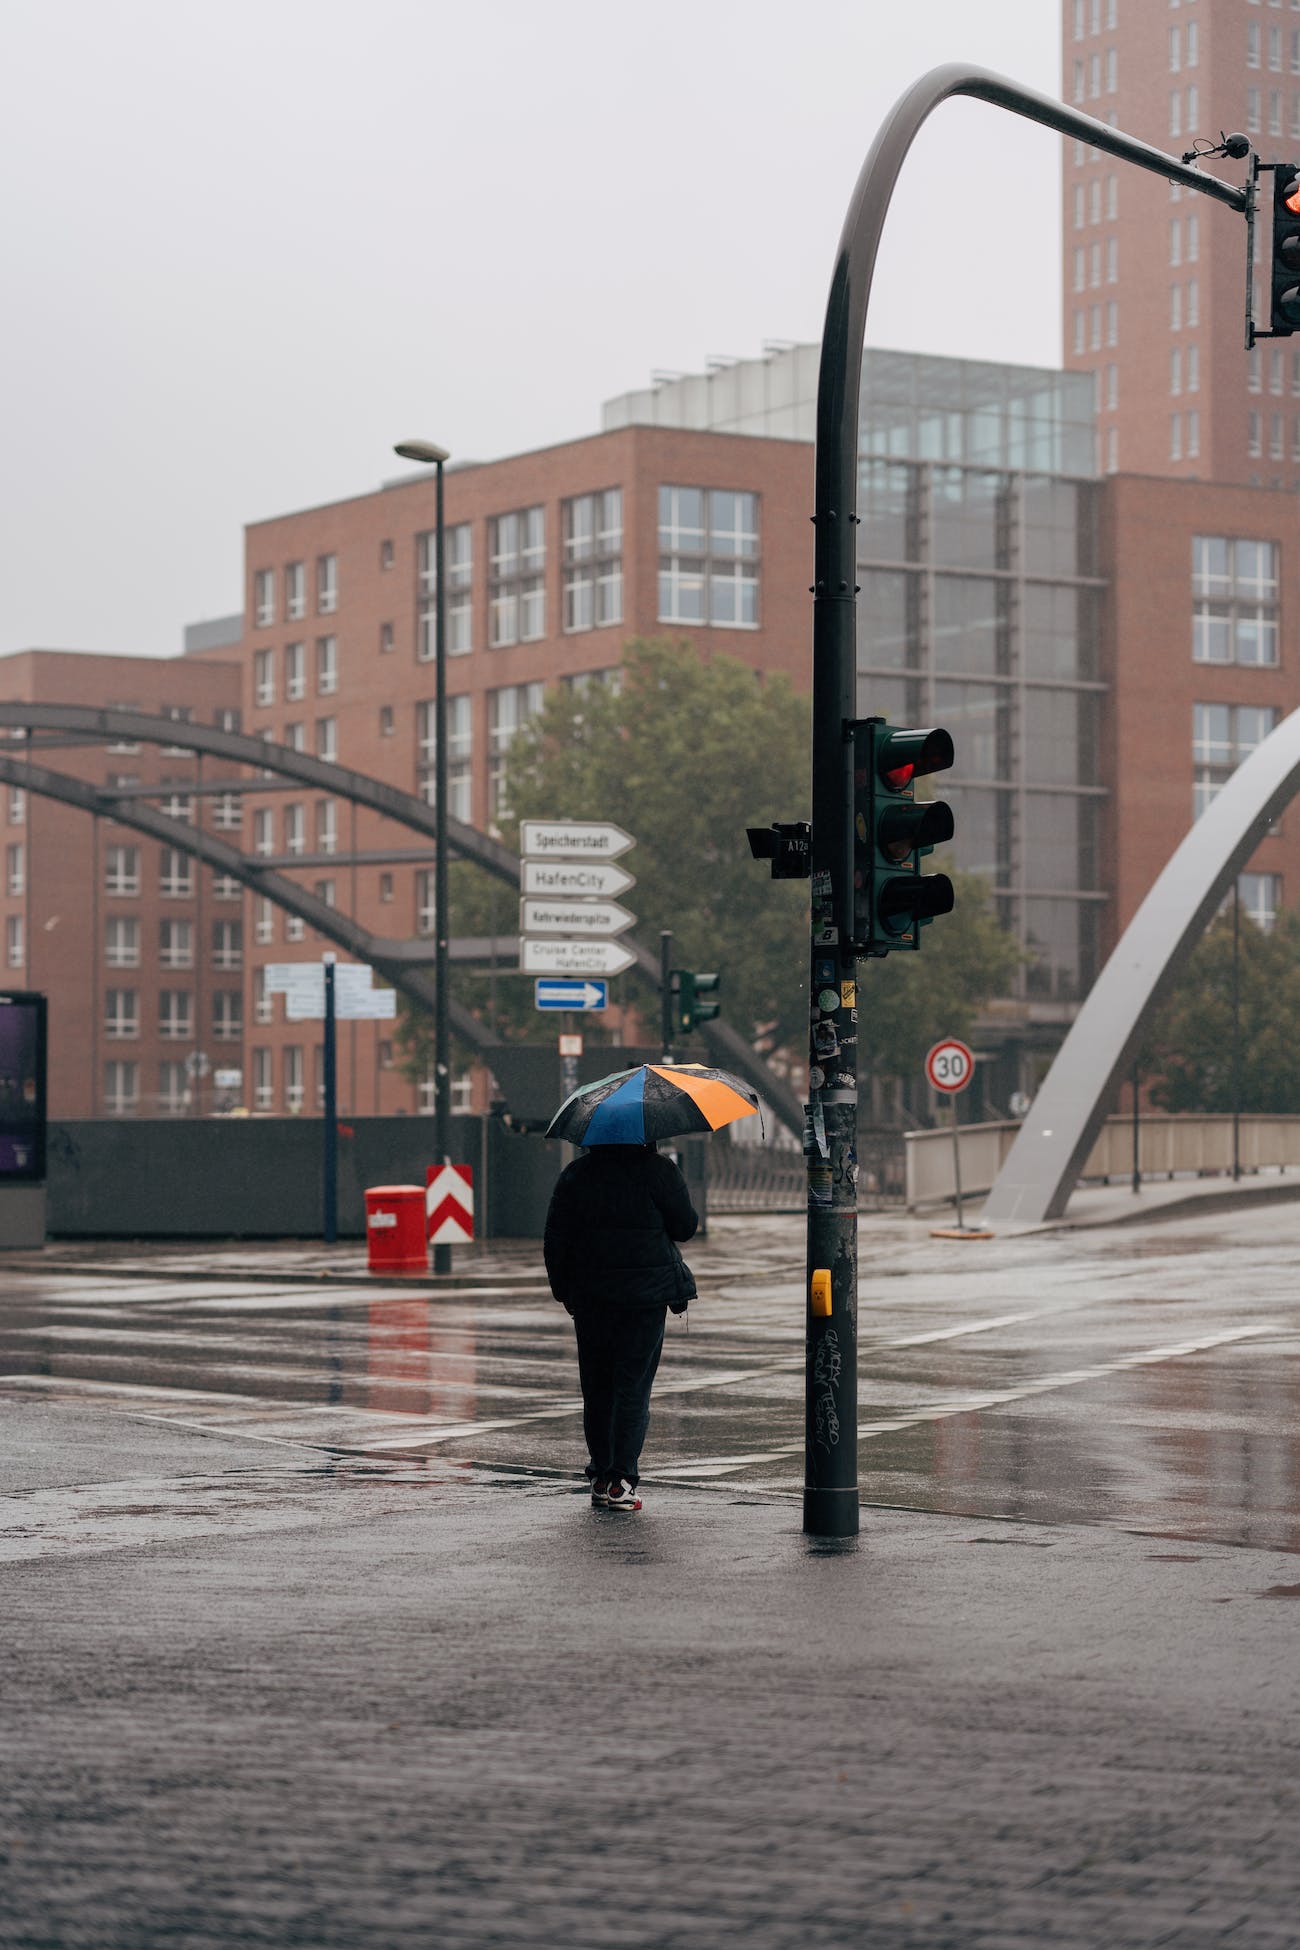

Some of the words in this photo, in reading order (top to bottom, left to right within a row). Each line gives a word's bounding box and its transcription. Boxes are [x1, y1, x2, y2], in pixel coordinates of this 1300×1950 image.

[536, 832, 609, 850] Speicherstadt
[535, 870, 605, 890] HafenCity
[532, 943, 567, 955] Cruise
[571, 944, 606, 956] Center
[556, 958, 607, 971] HafenCity
[937, 1055, 963, 1078] 30
